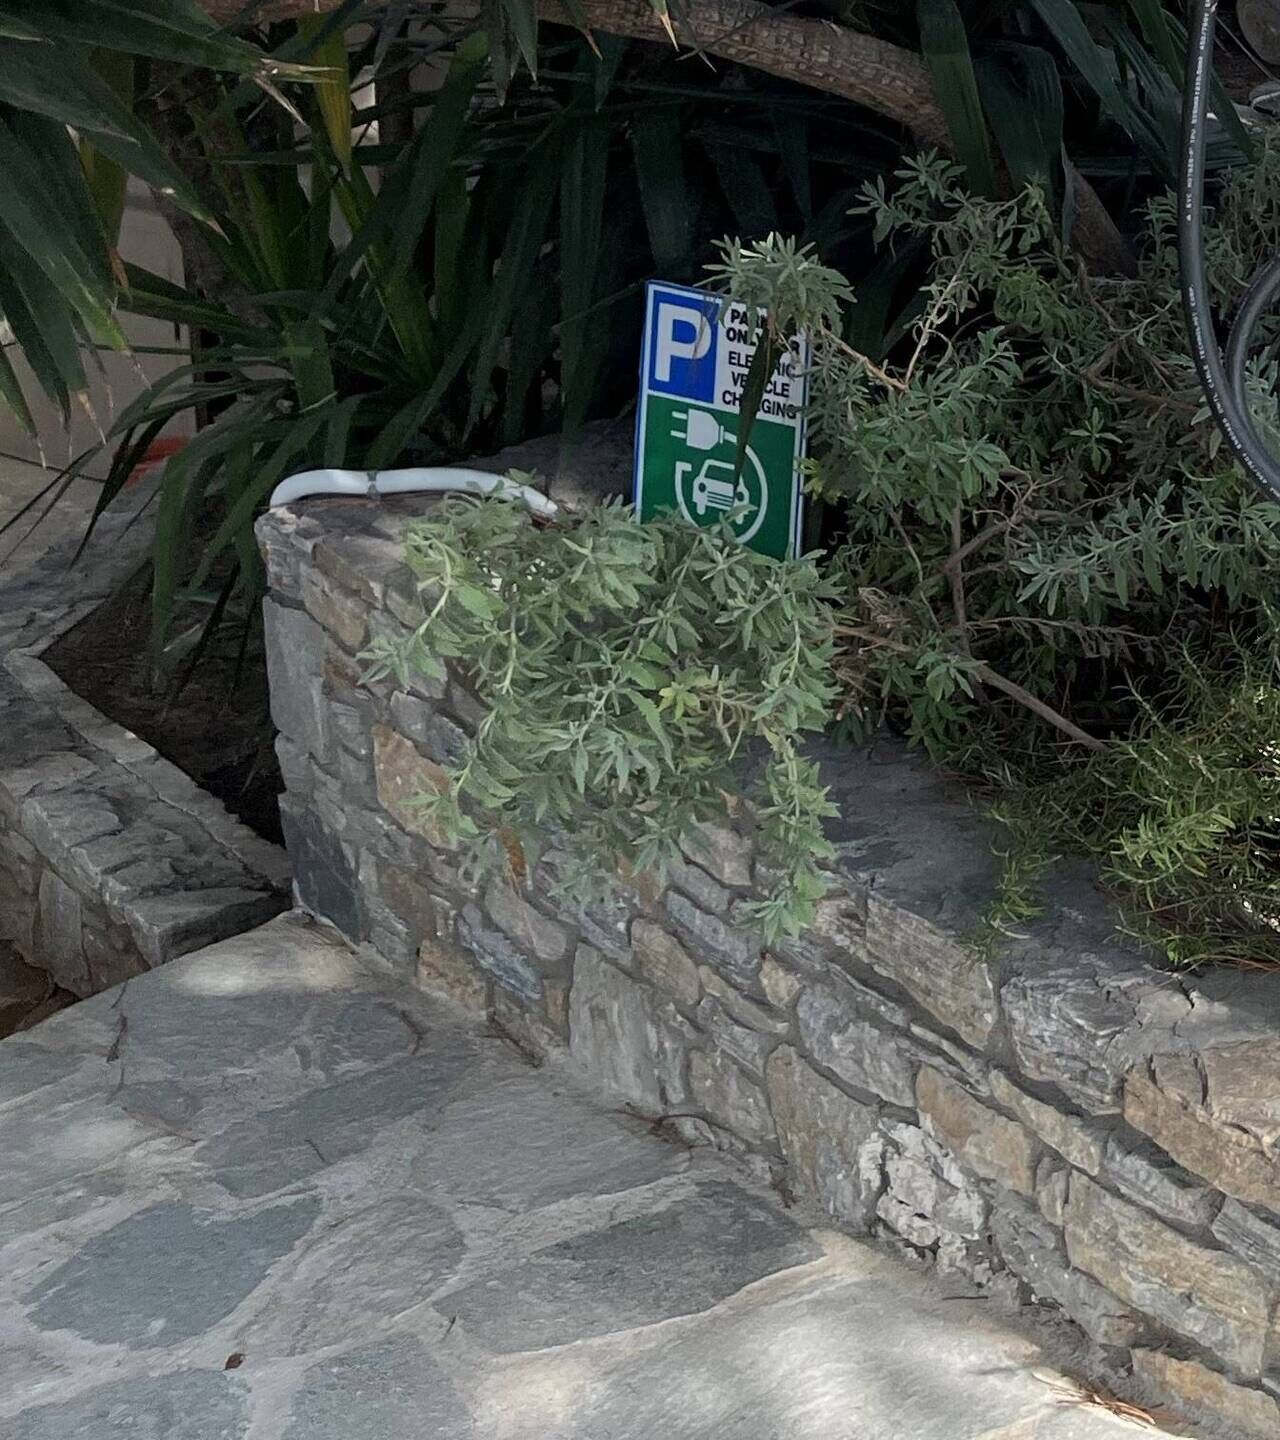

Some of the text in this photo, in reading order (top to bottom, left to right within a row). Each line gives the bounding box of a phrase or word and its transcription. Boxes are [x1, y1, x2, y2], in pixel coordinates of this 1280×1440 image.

[654, 302, 712, 382] P
[731, 371, 791, 399] VECLE
[721, 390, 798, 420] CHGING
